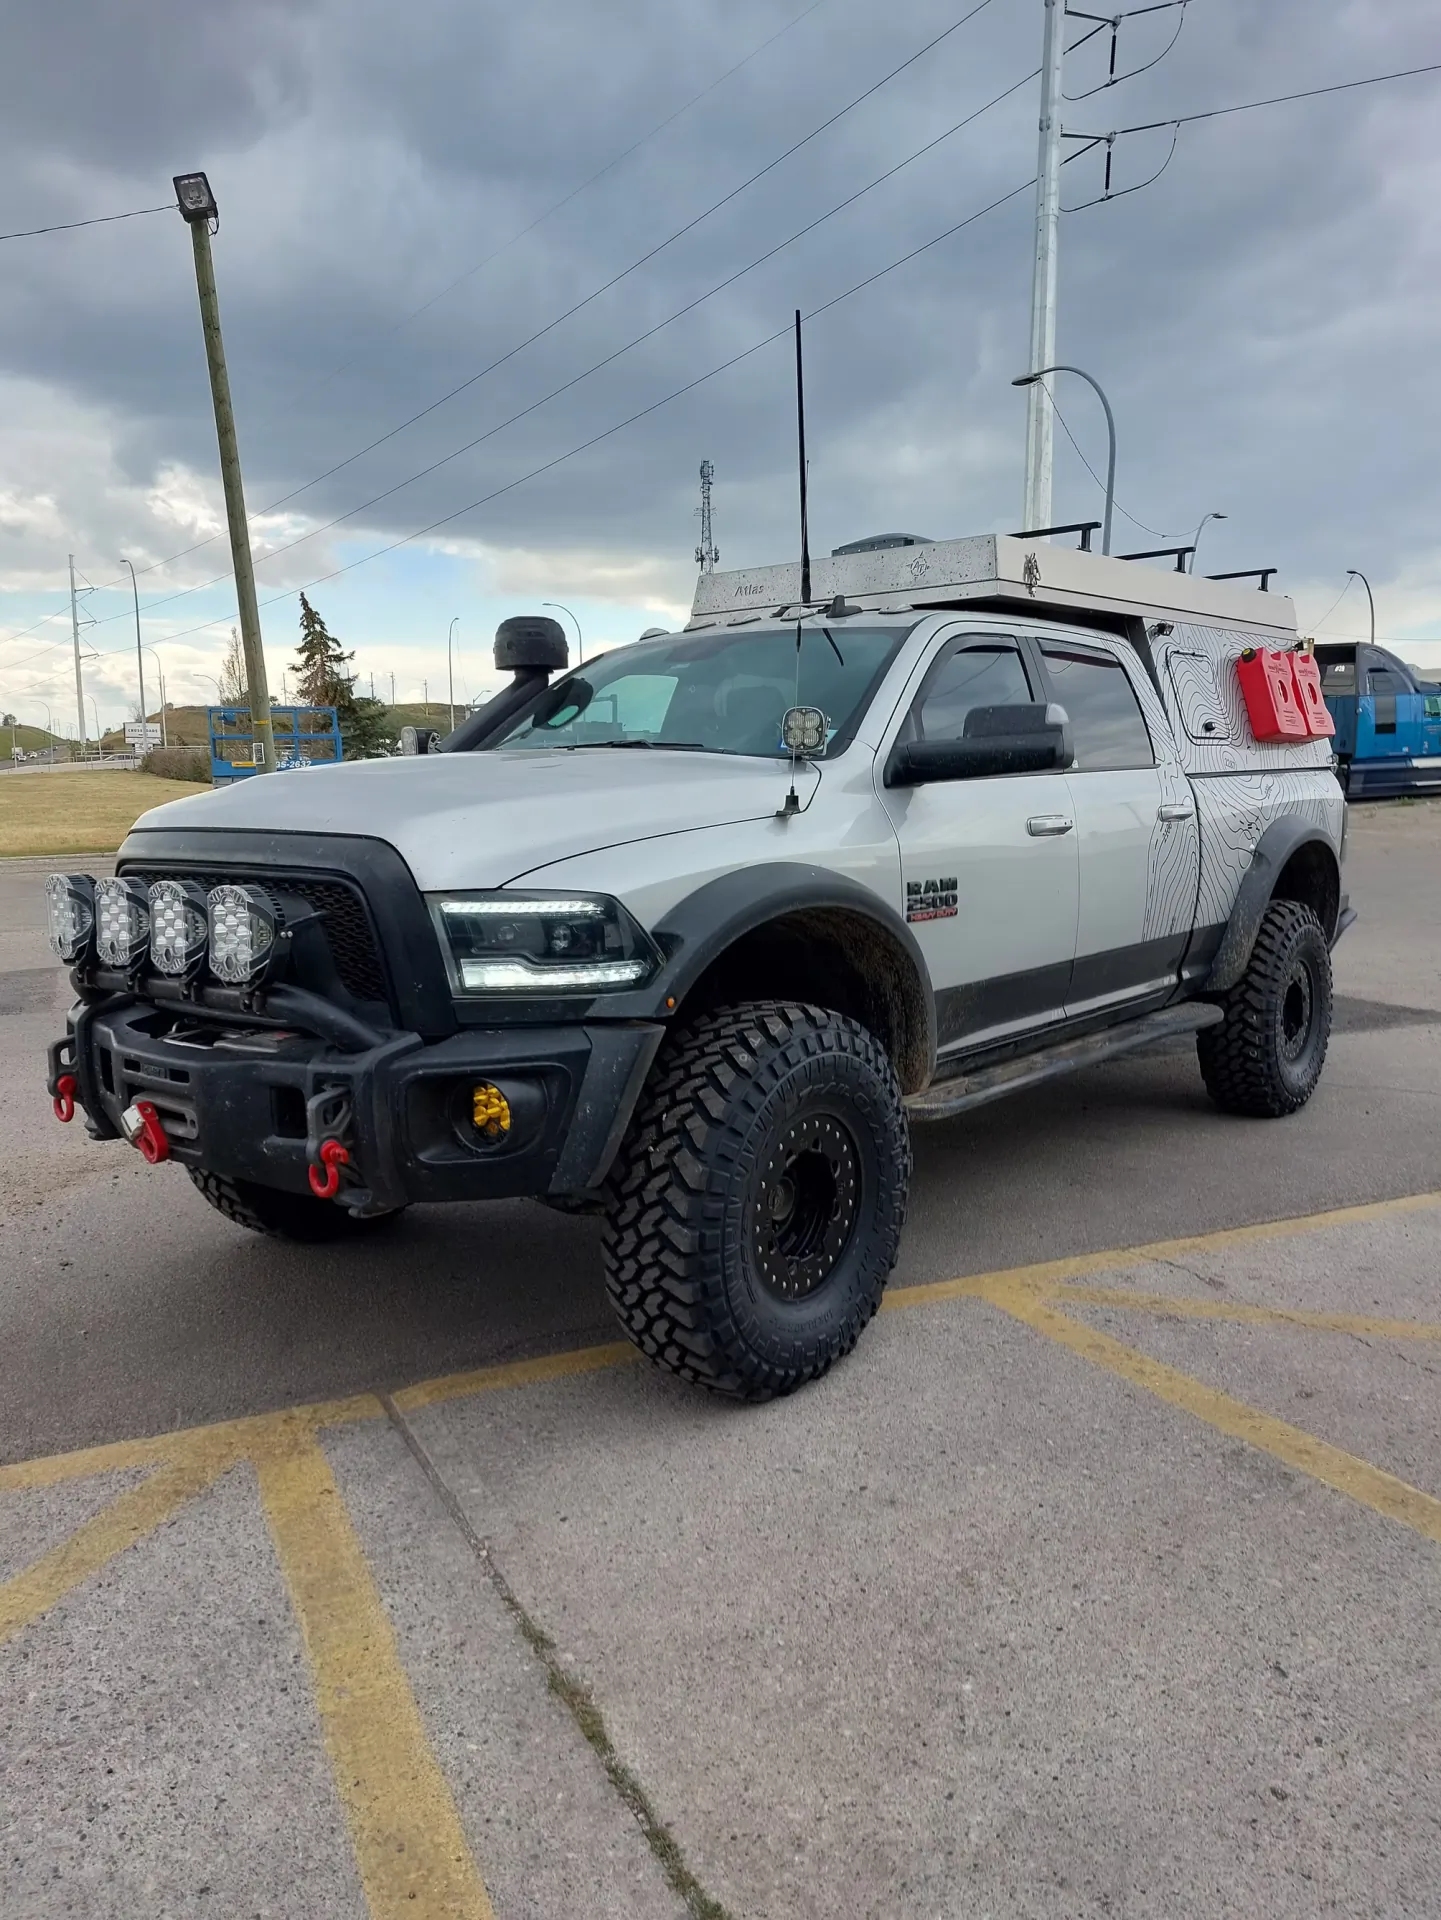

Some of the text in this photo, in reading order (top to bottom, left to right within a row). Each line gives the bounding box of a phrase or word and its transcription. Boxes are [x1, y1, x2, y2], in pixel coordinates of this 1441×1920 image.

[734, 584, 764, 597] Atlas
[907, 877, 958, 896] RAM
[907, 893, 958, 912] 2500
[910, 908, 957, 921] HEAVY DUTY
